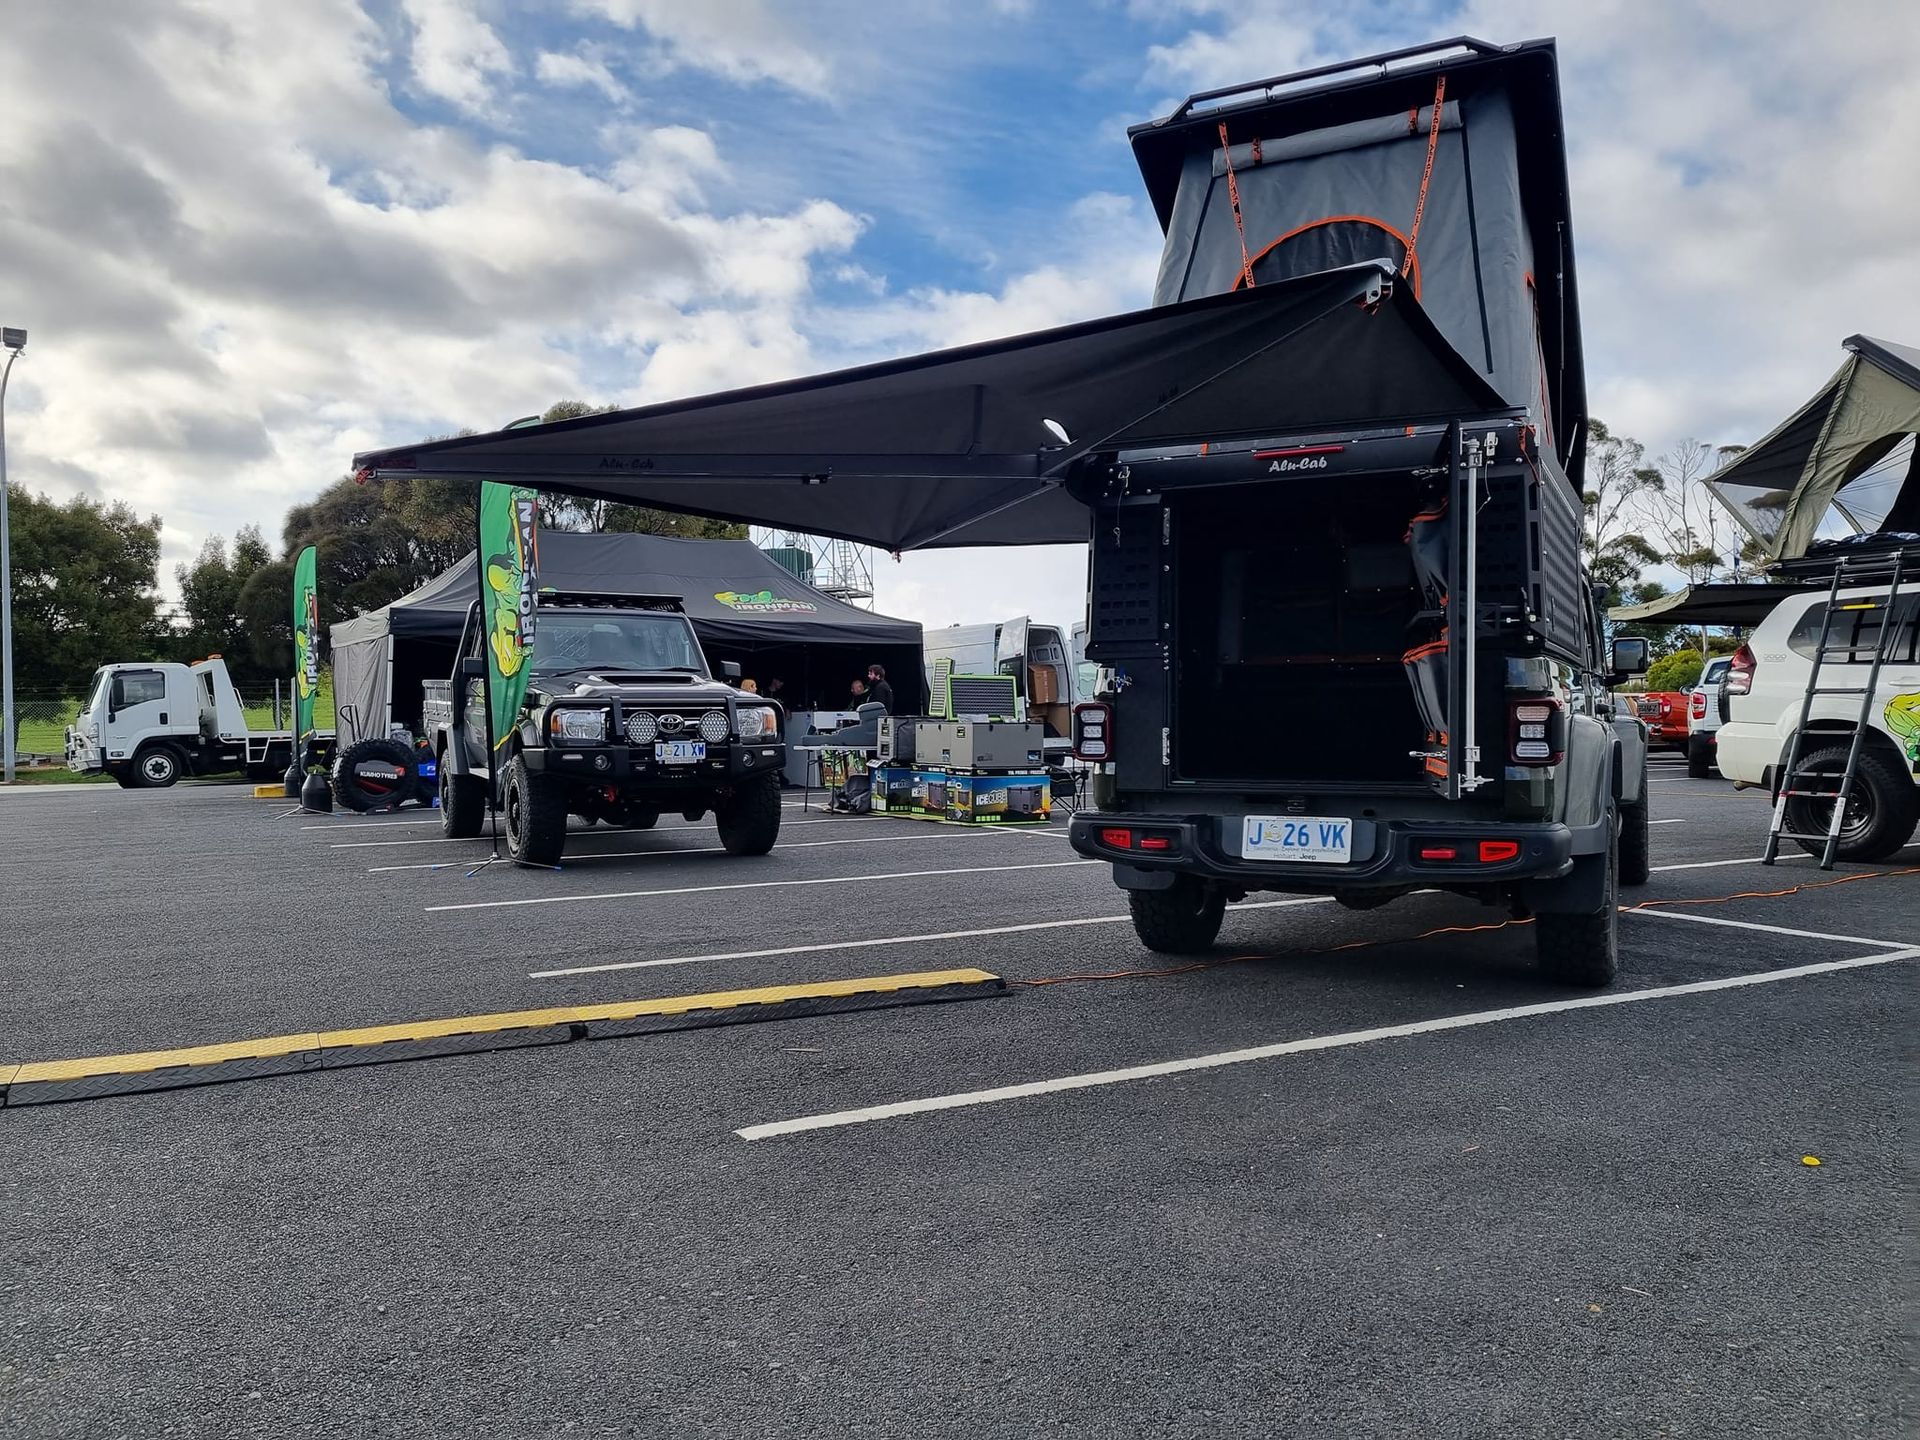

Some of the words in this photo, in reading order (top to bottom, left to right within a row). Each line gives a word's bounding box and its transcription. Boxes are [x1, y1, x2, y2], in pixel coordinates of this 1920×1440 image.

[1268, 456, 1327, 472] Alu-Cab
[656, 744, 663, 757] J
[674, 744, 686, 756] 21
[1249, 823, 1262, 845] J
[1283, 823, 1310, 847] 26
[1319, 824, 1346, 848] VK
